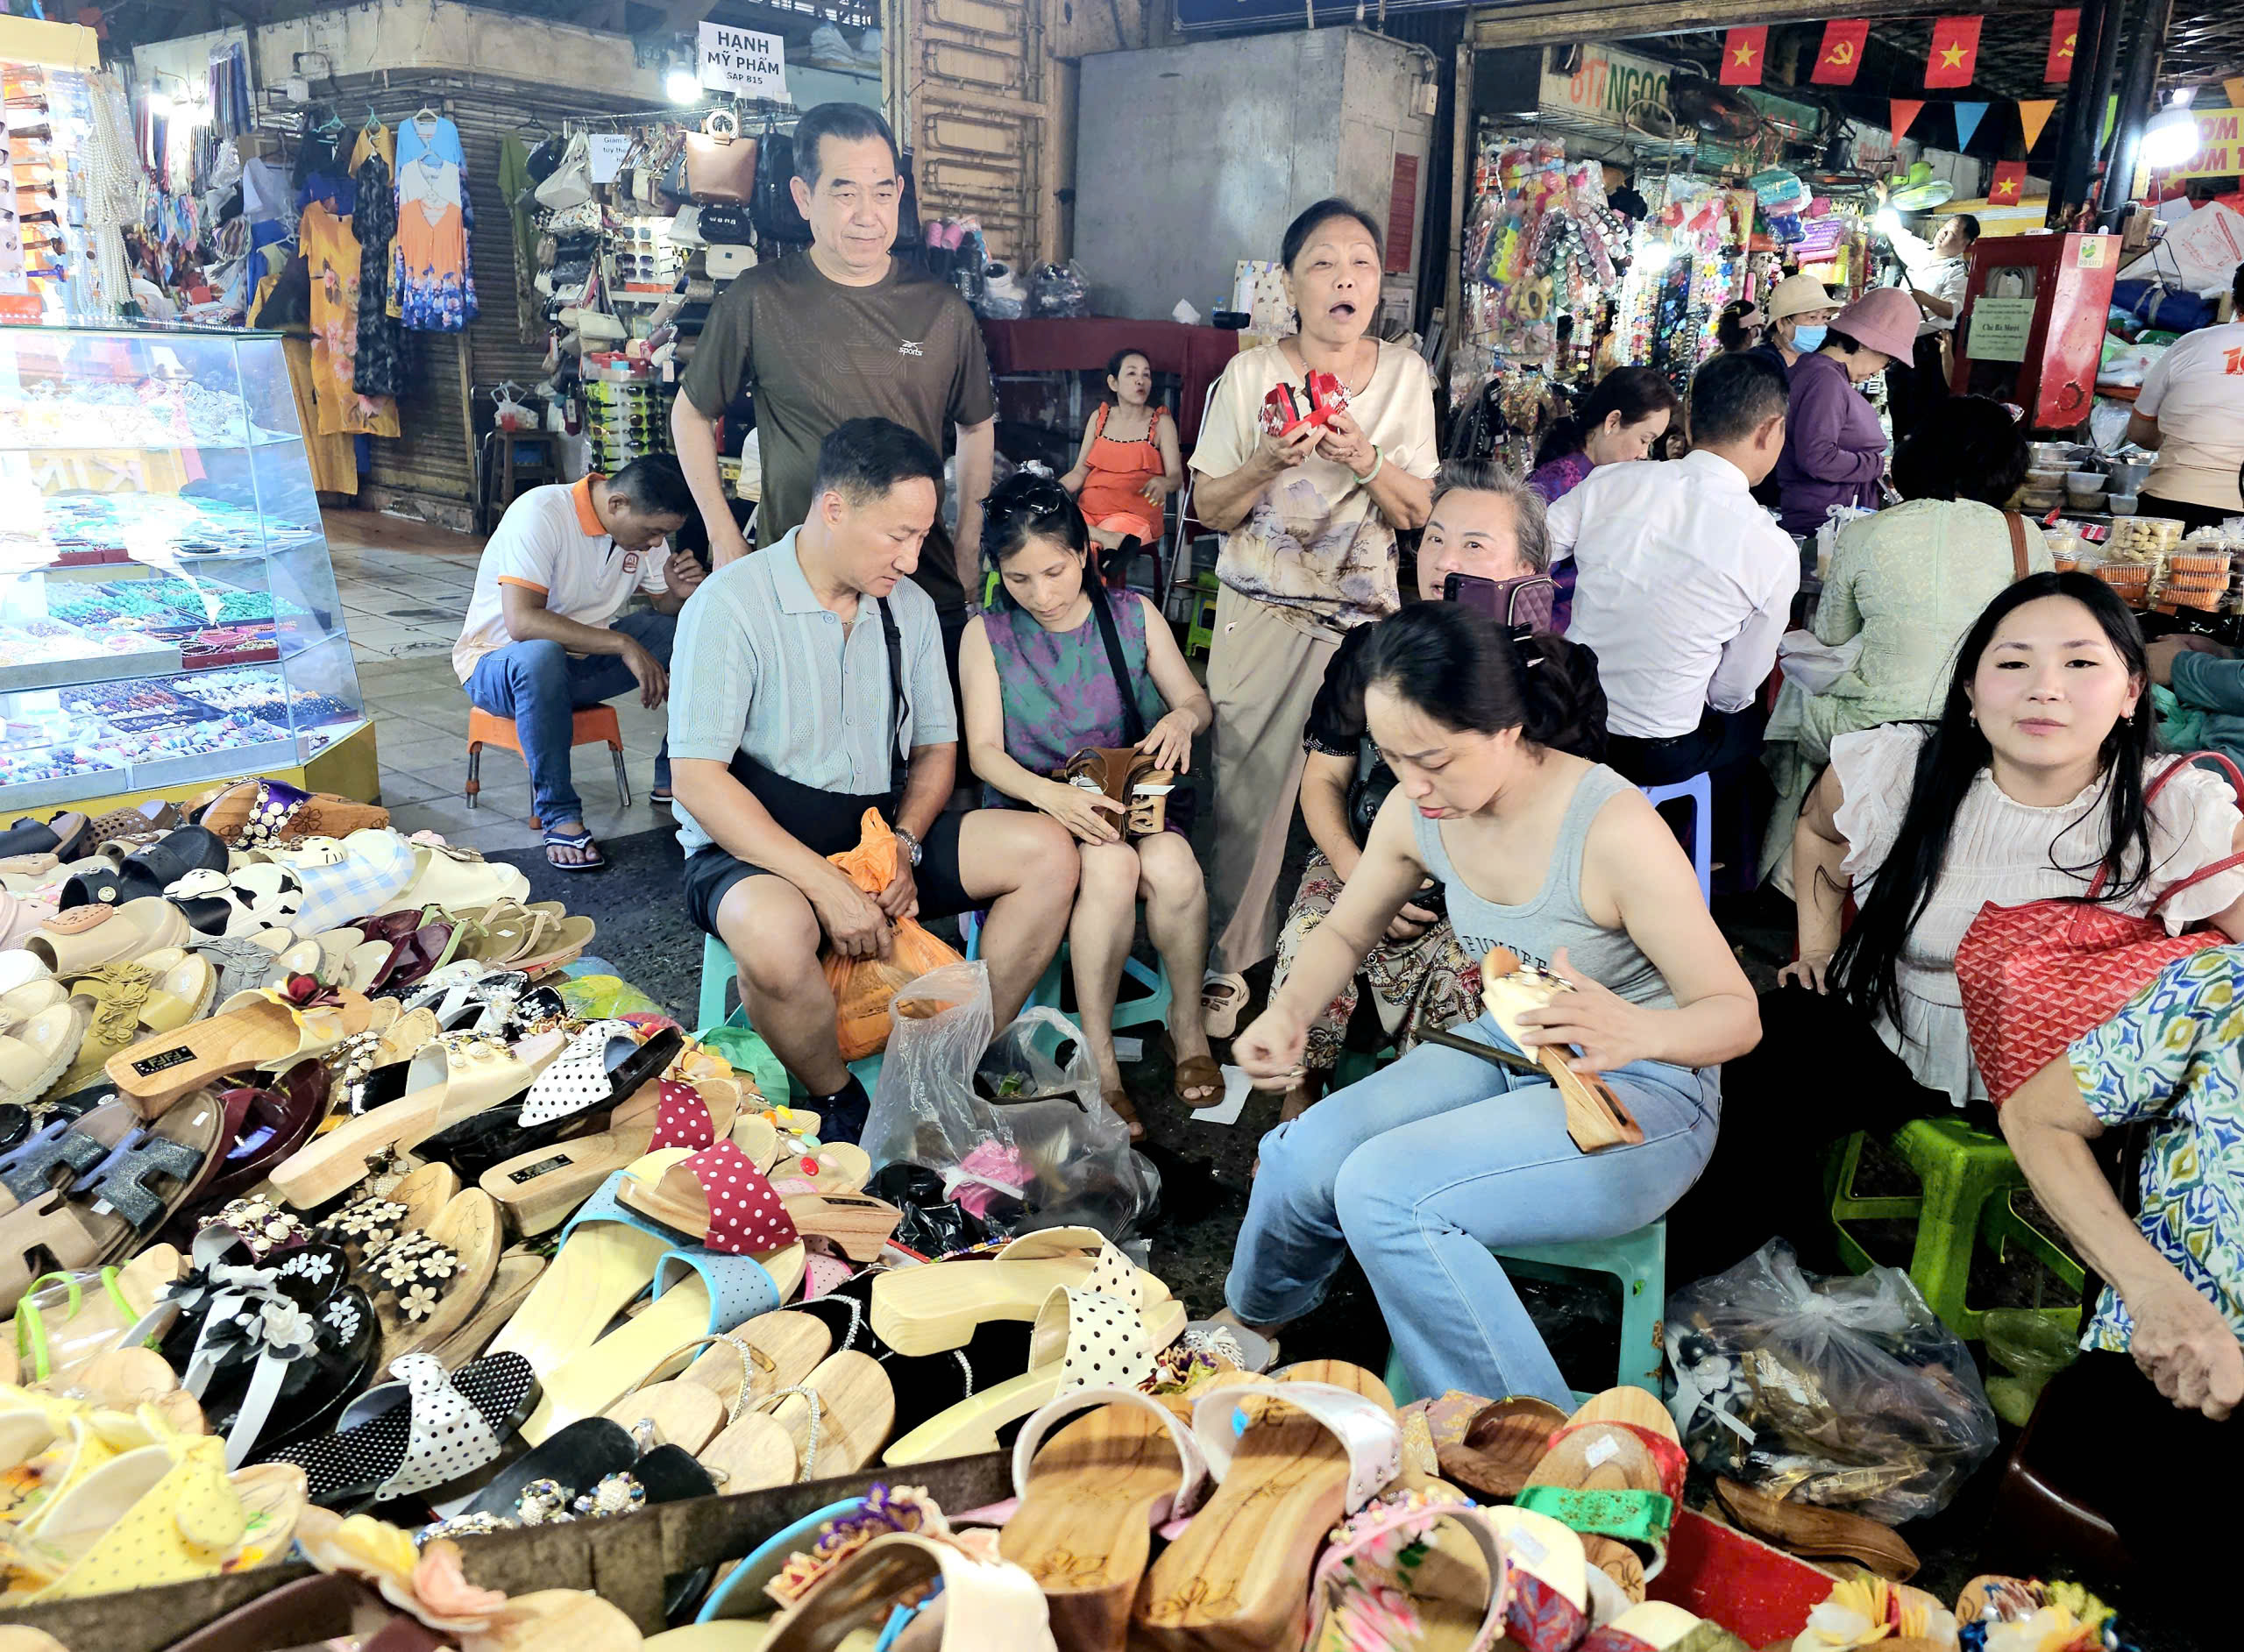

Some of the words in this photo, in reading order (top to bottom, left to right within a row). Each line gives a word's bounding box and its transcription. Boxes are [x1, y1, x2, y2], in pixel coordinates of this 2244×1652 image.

[718, 31, 770, 53] HẠNH
[707, 50, 731, 67] MỸ
[736, 56, 779, 75] PHẨM
[746, 75, 763, 85] 815
[898, 347, 924, 357] sports
